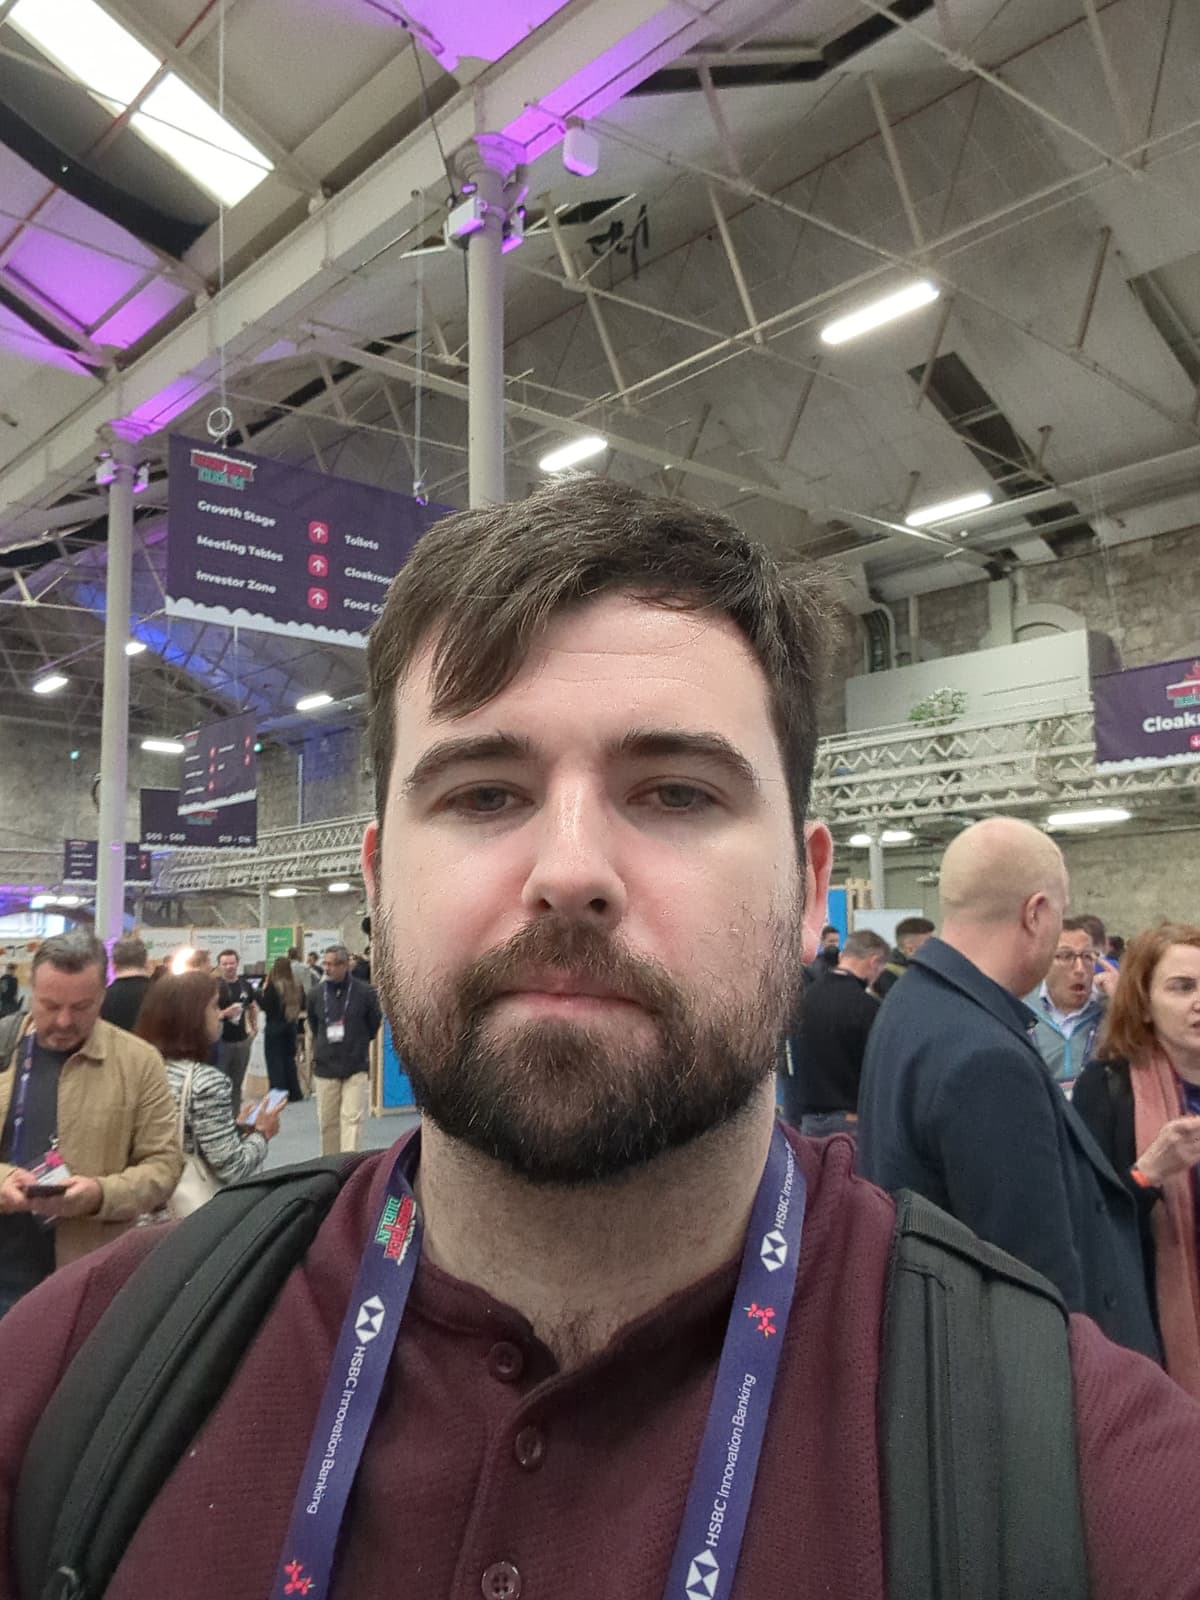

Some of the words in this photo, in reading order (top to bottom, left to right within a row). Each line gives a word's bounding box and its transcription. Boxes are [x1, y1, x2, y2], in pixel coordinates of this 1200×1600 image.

[197, 500, 242, 519] Growth
[243, 510, 276, 527] Stage
[196, 534, 246, 555] Meeting
[247, 545, 283, 562] Tables
[344, 534, 379, 551] Toilets
[196, 570, 246, 588] Investor
[246, 579, 277, 594] Zone
[343, 598, 370, 612] Food
[774, 1194, 790, 1230] HSBC
[345, 1346, 366, 1388] HSBC
[324, 1389, 354, 1458] Innovation
[705, 1499, 727, 1547] HSBC
[718, 1429, 743, 1498] Innovation
[732, 1373, 757, 1428] Banking
[306, 1457, 336, 1515] Banking
